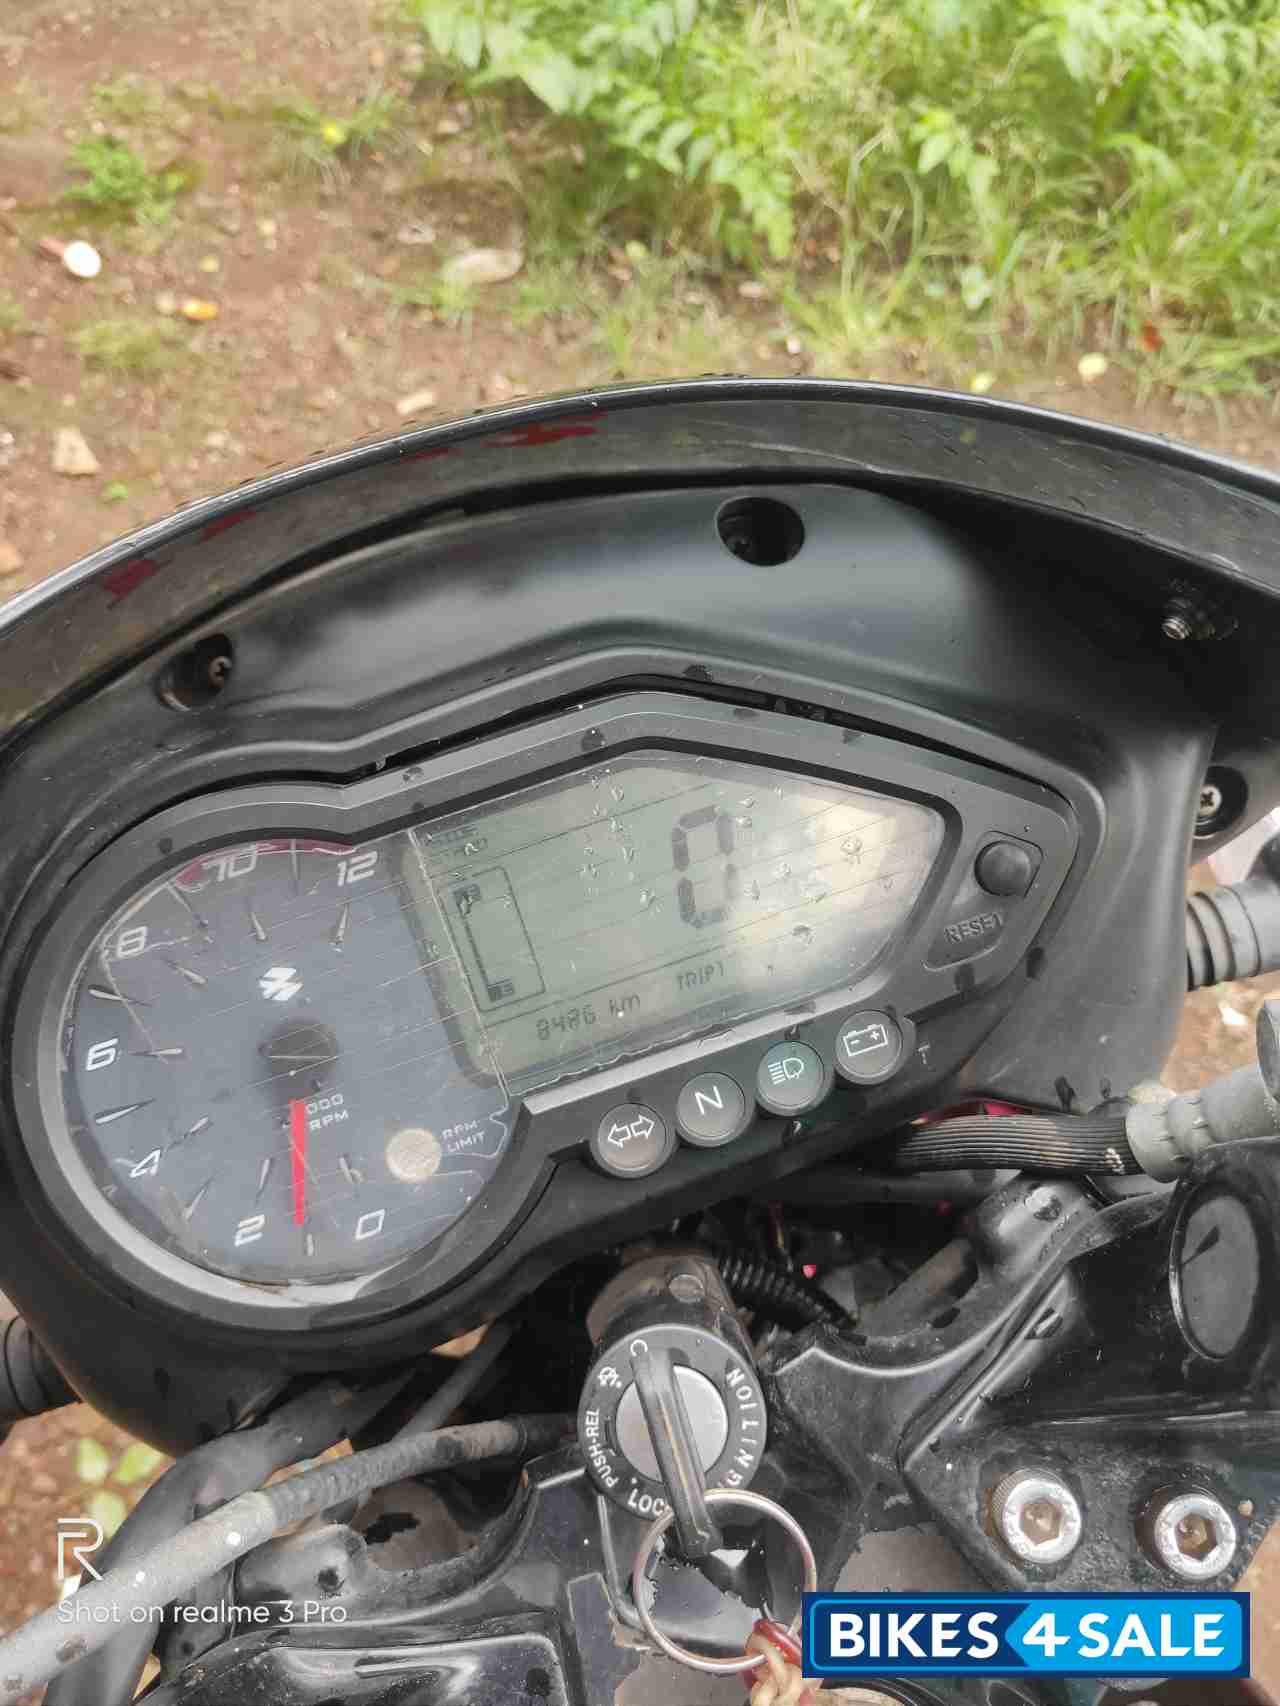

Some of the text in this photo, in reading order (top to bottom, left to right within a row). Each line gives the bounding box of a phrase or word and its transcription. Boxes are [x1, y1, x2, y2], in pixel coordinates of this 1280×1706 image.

[337, 851, 378, 886] 12
[116, 926, 149, 959] 8
[944, 912, 1003, 944] RESET
[85, 1038, 119, 1071] 6
[695, 1087, 723, 1115] N
[309, 1109, 350, 1131] RPM
[442, 1119, 479, 1140] RPM
[447, 1131, 487, 1153] LIMIT
[129, 1150, 162, 1179] 4
[235, 1214, 266, 1247] 2
[715, 1367, 761, 1488] GNITION
[628, 1490, 674, 1517] LOC
